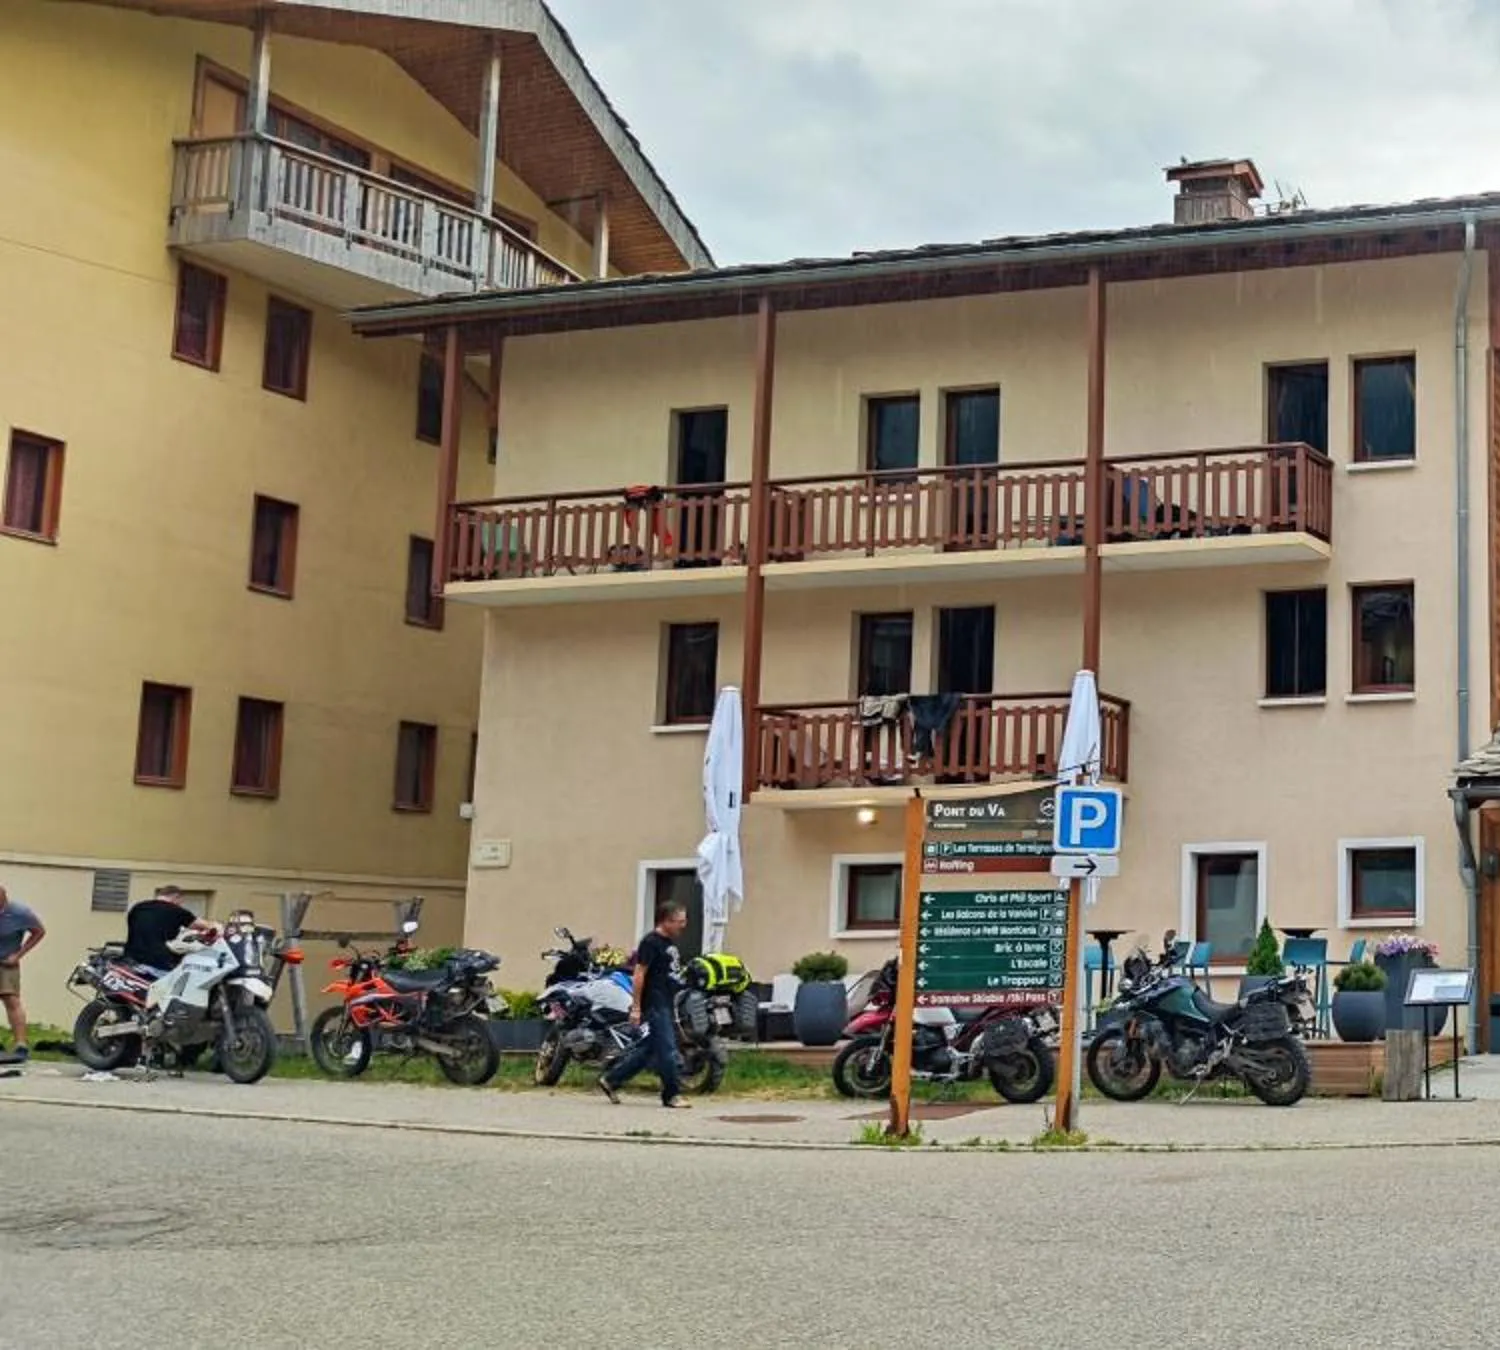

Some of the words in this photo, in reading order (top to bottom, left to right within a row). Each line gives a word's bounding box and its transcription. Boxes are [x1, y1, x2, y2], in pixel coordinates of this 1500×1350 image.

[1070, 797, 1108, 845] P
[1005, 844, 1015, 853] de
[975, 893, 997, 903] Chris
[999, 893, 1008, 903] et
[1009, 893, 1026, 903] Phil
[1027, 892, 1052, 904] Sport
[1011, 958, 1048, 969] L'Escale
[987, 976, 999, 986] Le
[1001, 975, 1047, 987] Trappeur
